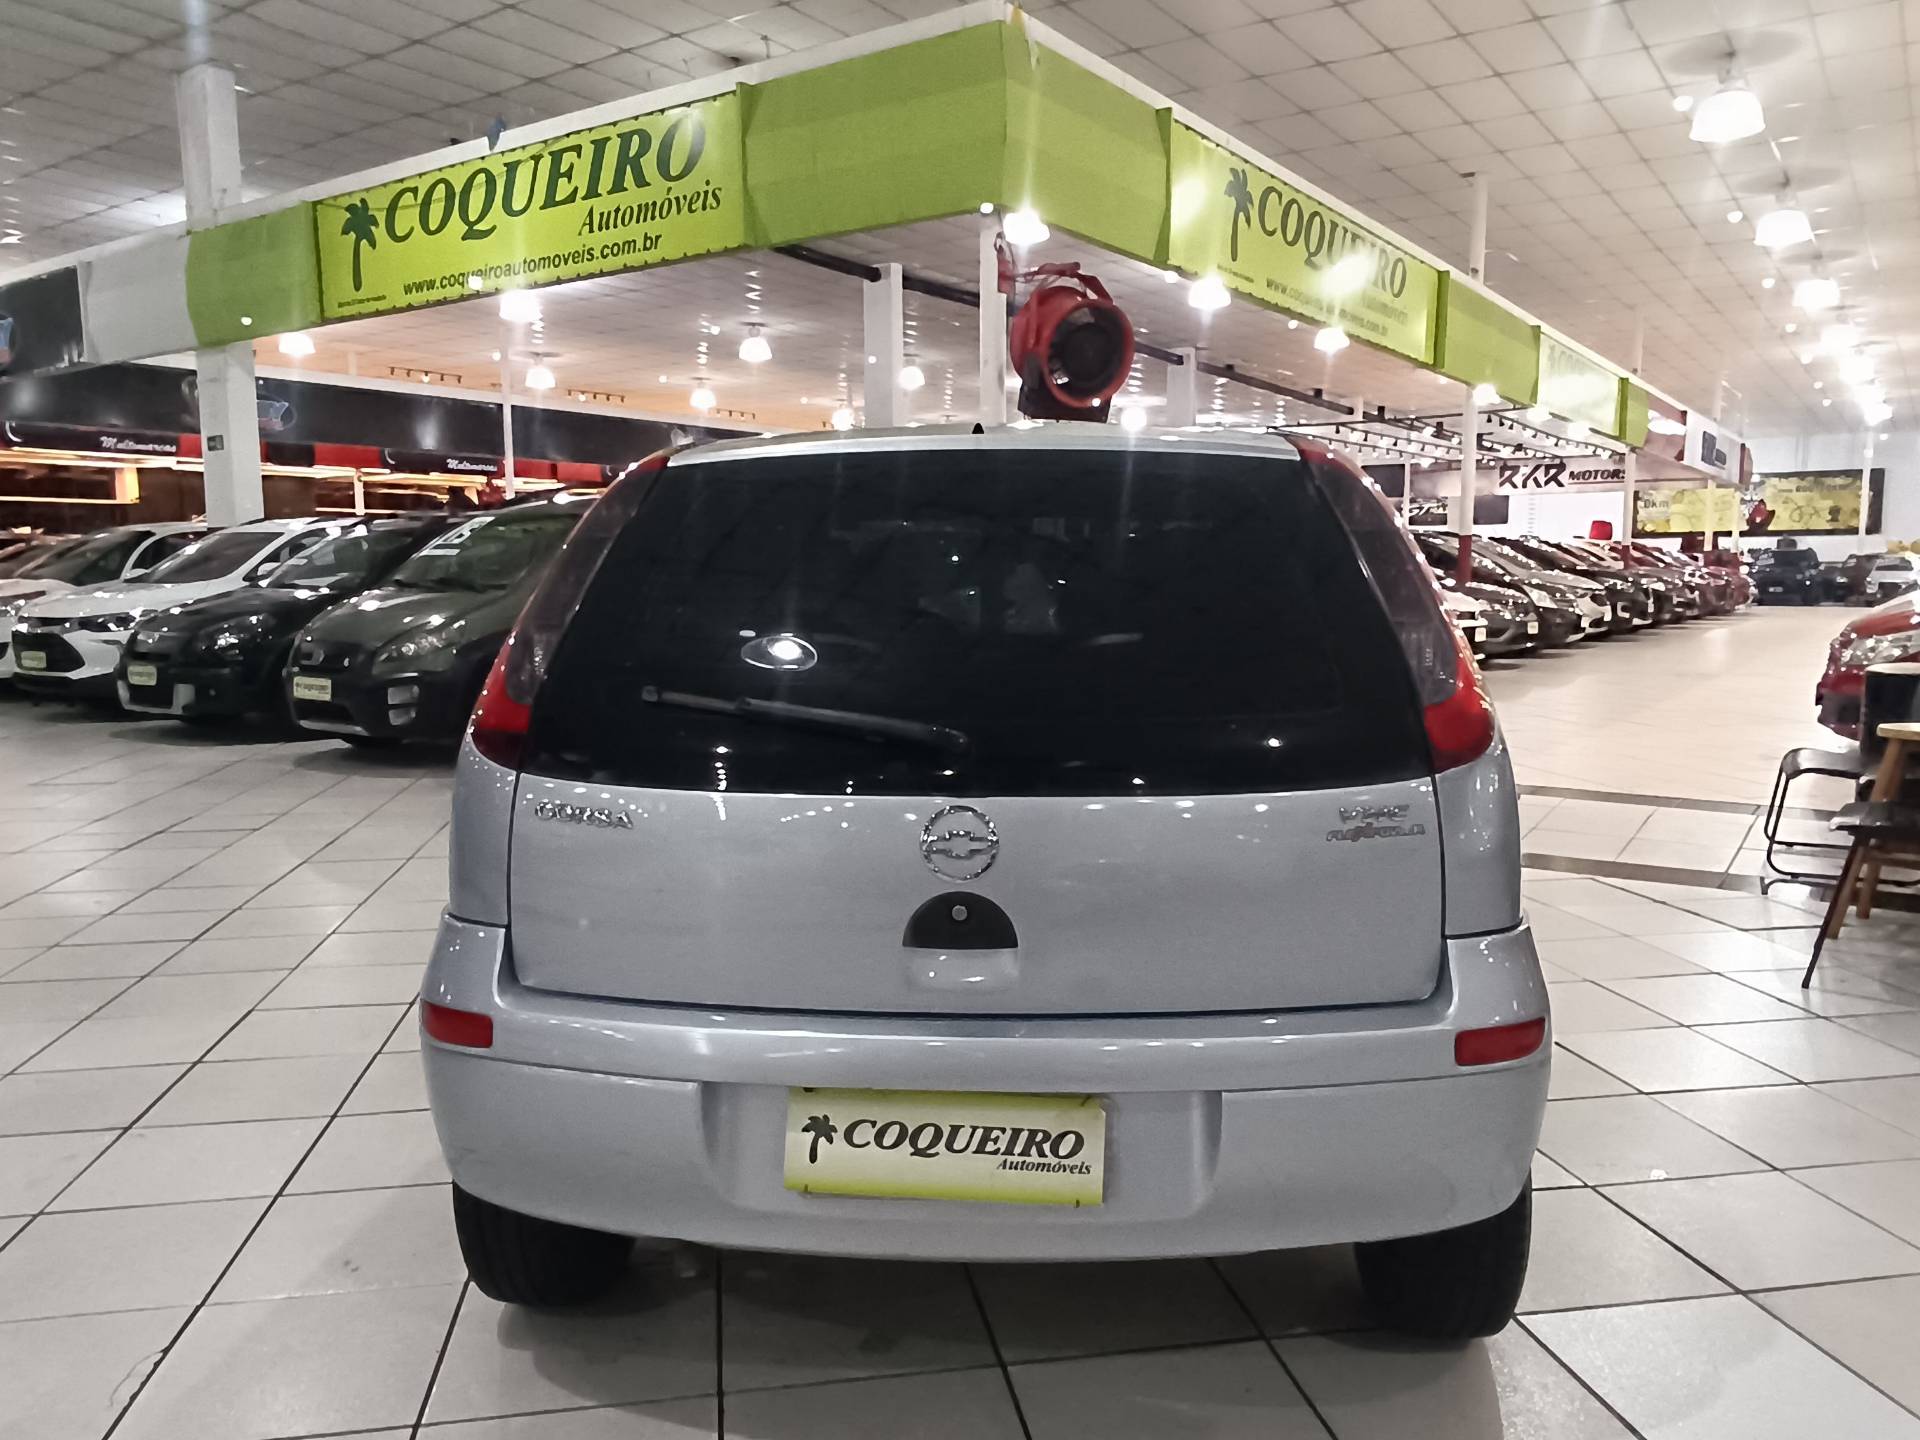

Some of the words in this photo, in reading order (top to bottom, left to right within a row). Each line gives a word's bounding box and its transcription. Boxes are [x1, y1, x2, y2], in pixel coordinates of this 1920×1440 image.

[385, 115, 707, 243] COQUEIRO
[578, 179, 722, 236] Automóveis
[1258, 186, 1408, 298] COQURO
[842, 1118, 1086, 1160] COQUEIRO
[996, 1158, 1092, 1175] Automóveis
